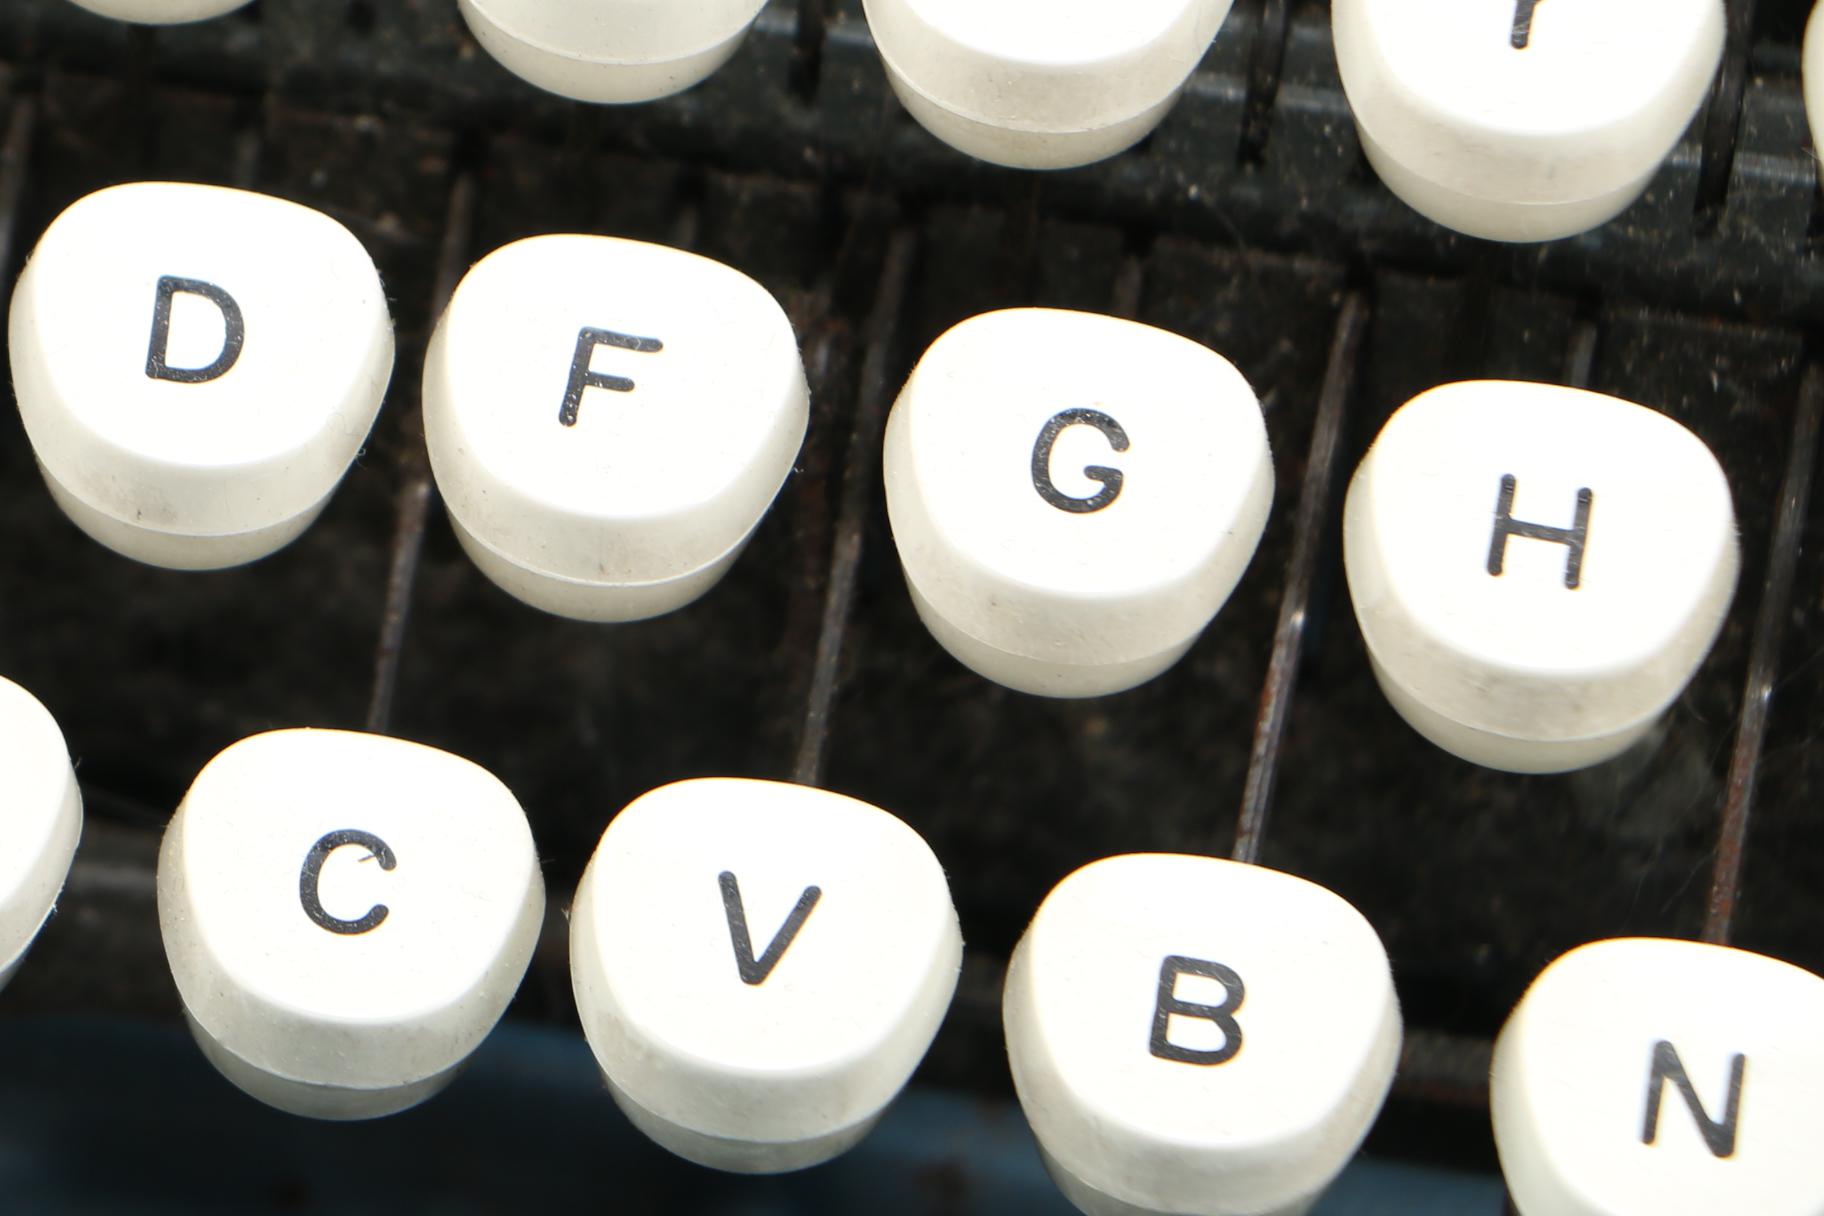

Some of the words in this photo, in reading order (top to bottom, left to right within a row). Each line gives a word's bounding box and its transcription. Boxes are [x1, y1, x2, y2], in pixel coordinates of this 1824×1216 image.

[146, 276, 244, 383] D
[559, 328, 663, 426] F
[1032, 409, 1129, 513] G
[1487, 475, 1592, 589] H
[300, 830, 396, 934] C
[719, 872, 821, 985] V
[1150, 956, 1244, 1066] B
[1643, 1041, 1745, 1158] N
